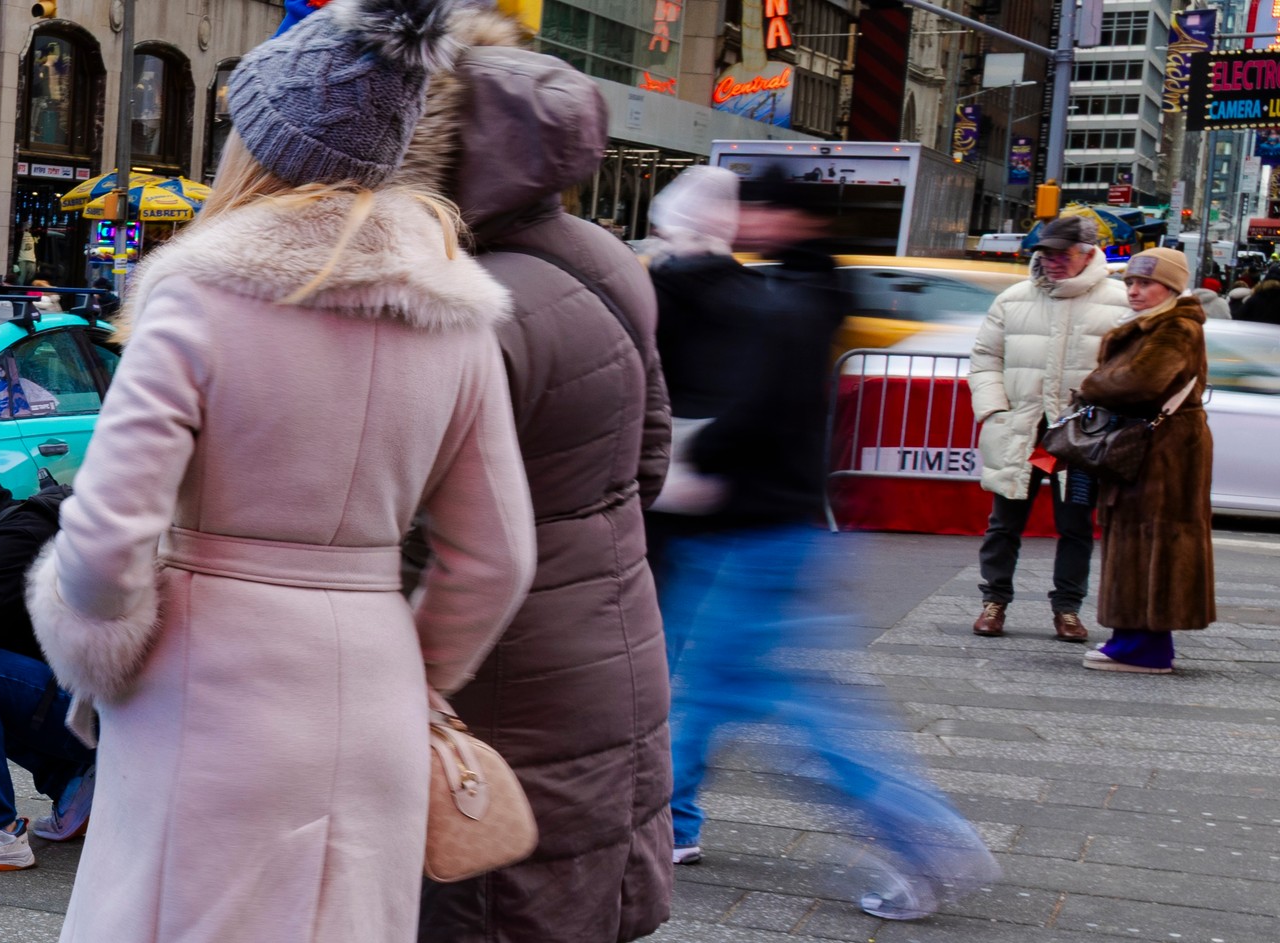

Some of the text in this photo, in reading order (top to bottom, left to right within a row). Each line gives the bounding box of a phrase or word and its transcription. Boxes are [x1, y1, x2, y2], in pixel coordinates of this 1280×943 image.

[714, 67, 792, 103] Central
[1211, 60, 1280, 91] ELECTR
[1209, 99, 1262, 119] CAMERA
[143, 209, 189, 217] SABRETT
[898, 450, 976, 471] TIMES
